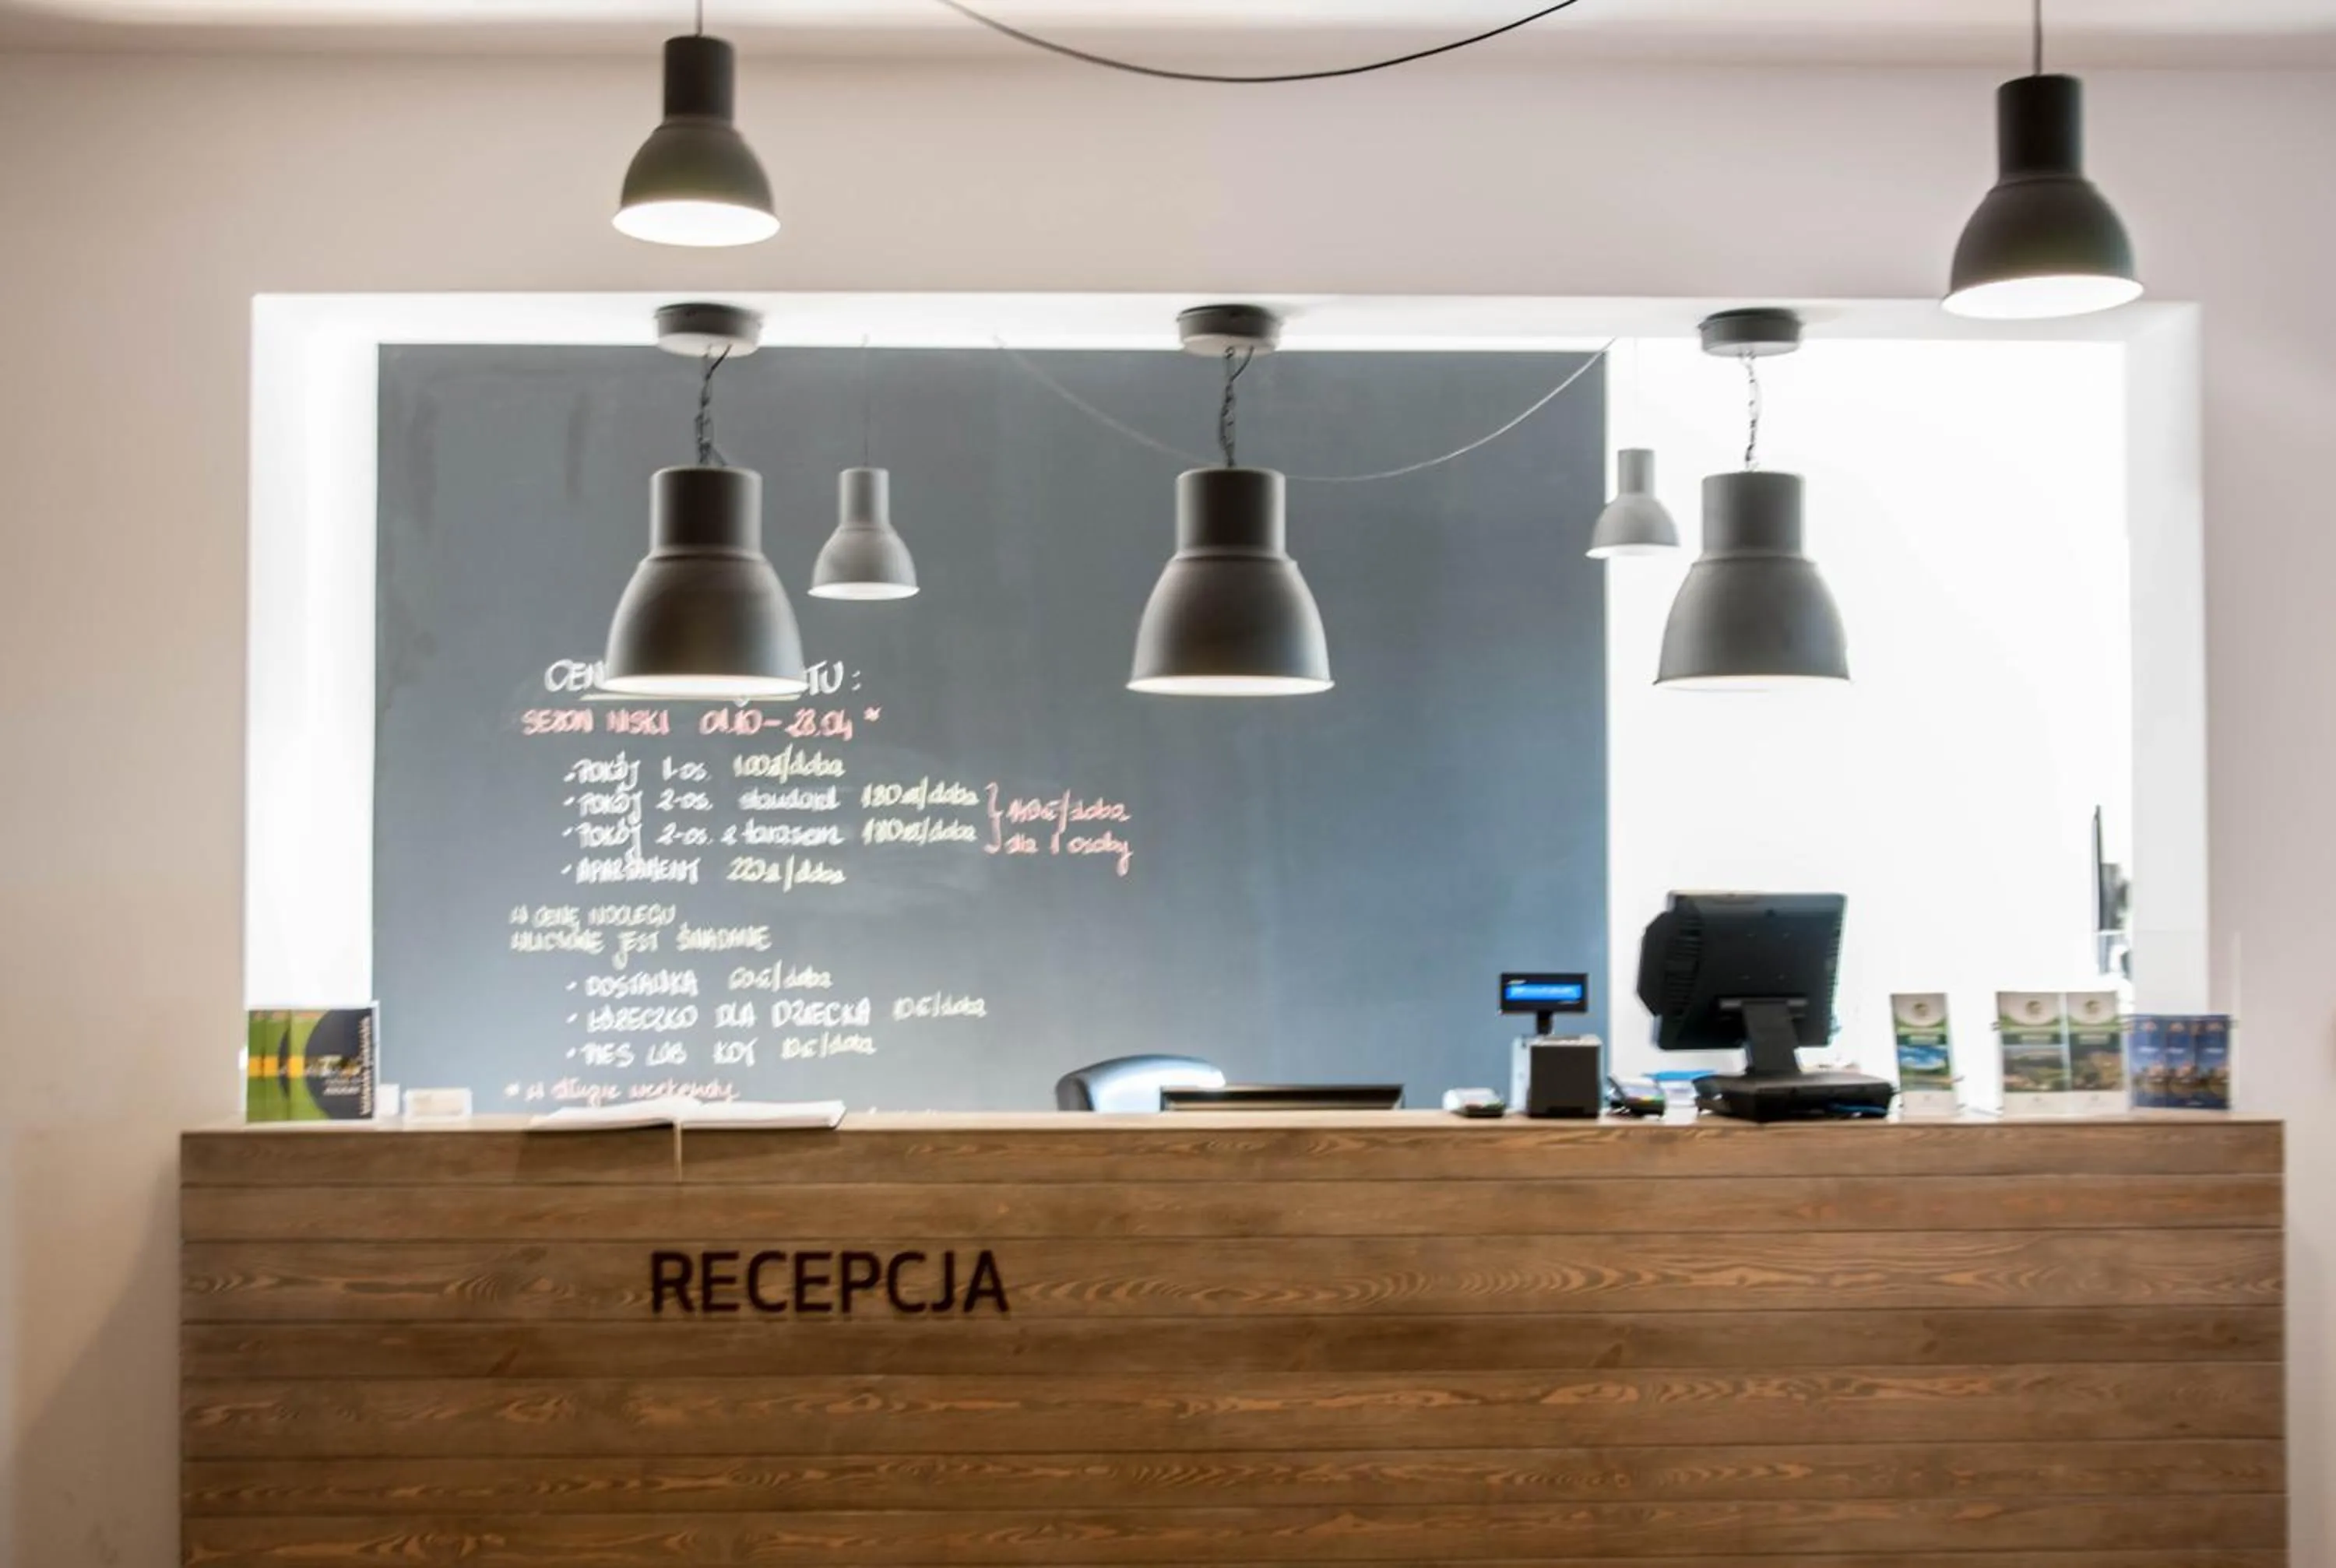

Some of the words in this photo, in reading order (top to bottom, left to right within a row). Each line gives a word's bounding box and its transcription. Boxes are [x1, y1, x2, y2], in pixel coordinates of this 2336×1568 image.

[521, 708, 594, 736] SEZON
[606, 708, 670, 736] NISKI
[584, 969, 699, 999] DOSTAWKA
[714, 1000, 757, 1028] DLA
[770, 996, 871, 1028] DZIECKA
[645, 1040, 688, 1067] LUB
[712, 1036, 759, 1067] KOT
[651, 1249, 1010, 1314] RECEPCJA
